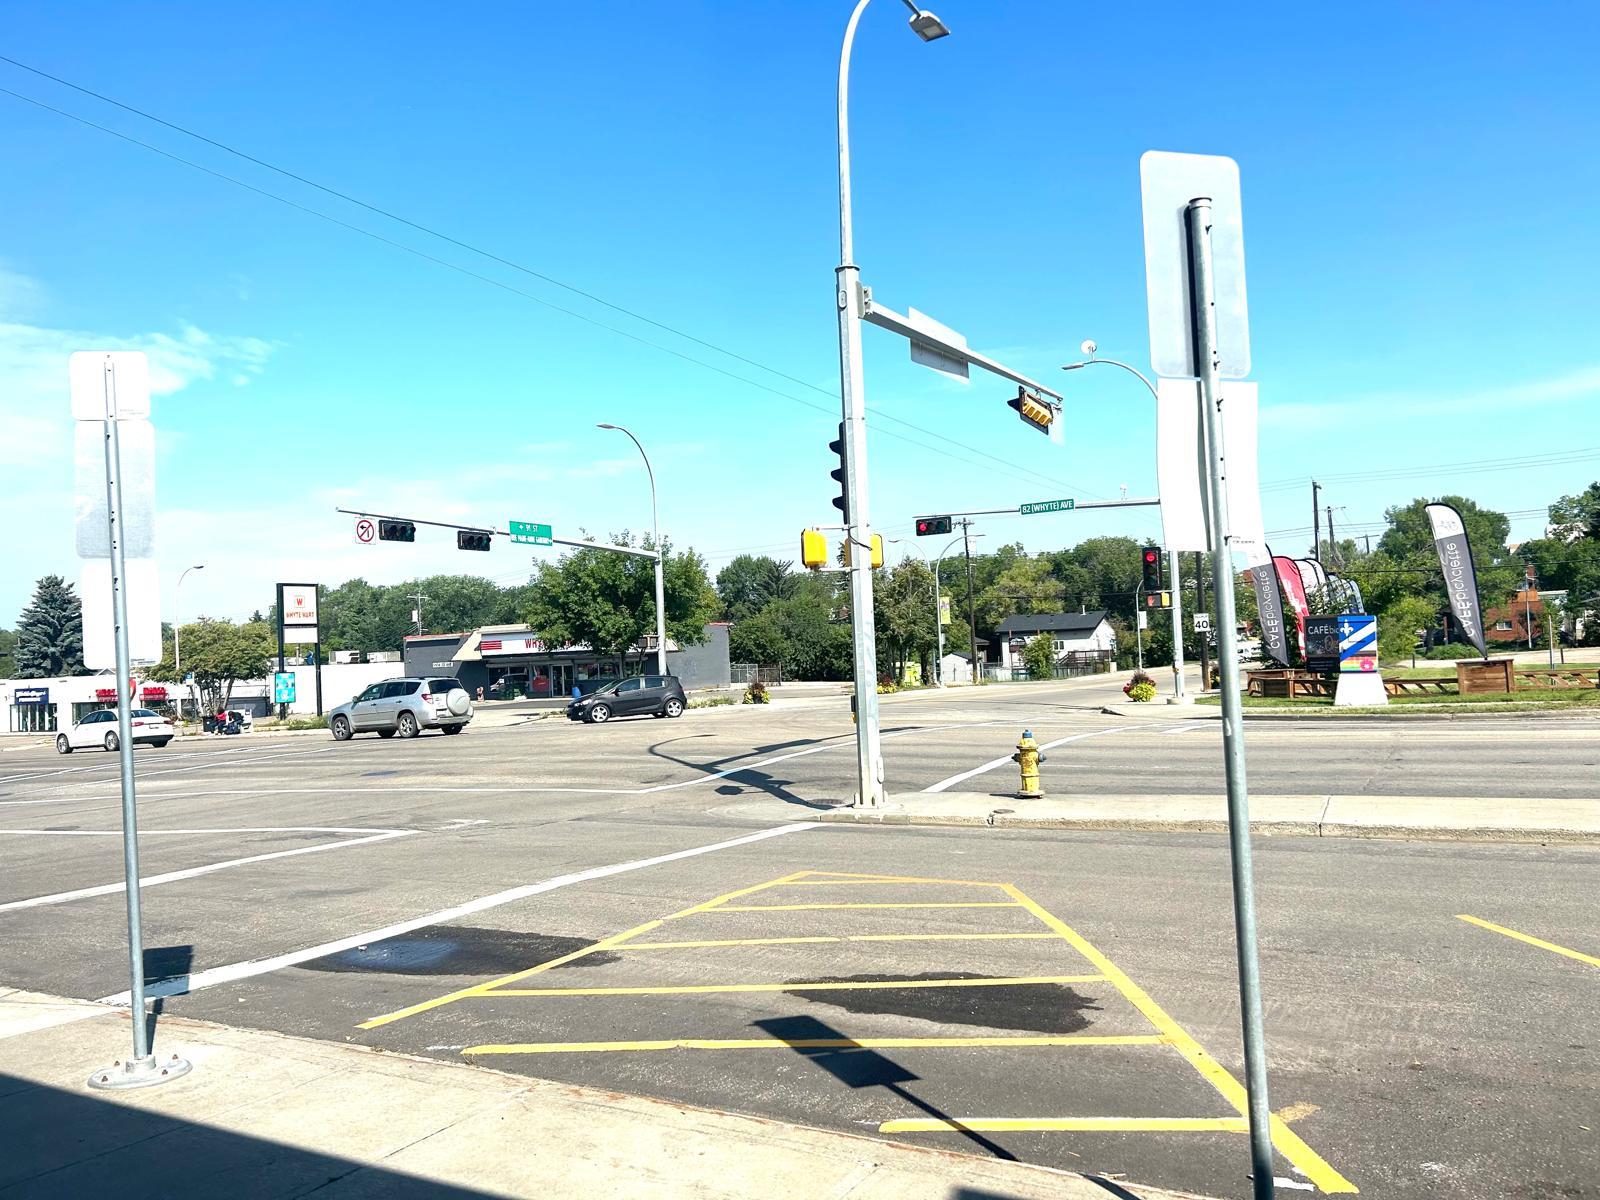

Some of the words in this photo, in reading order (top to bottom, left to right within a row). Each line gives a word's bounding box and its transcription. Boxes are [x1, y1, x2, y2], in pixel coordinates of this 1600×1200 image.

[1022, 505, 1031, 513] 82
[1032, 501, 1059, 513] (WHYTE)
[1060, 500, 1073, 510] AVE
[296, 597, 303, 606] W
[1195, 620, 1209, 629] 40
